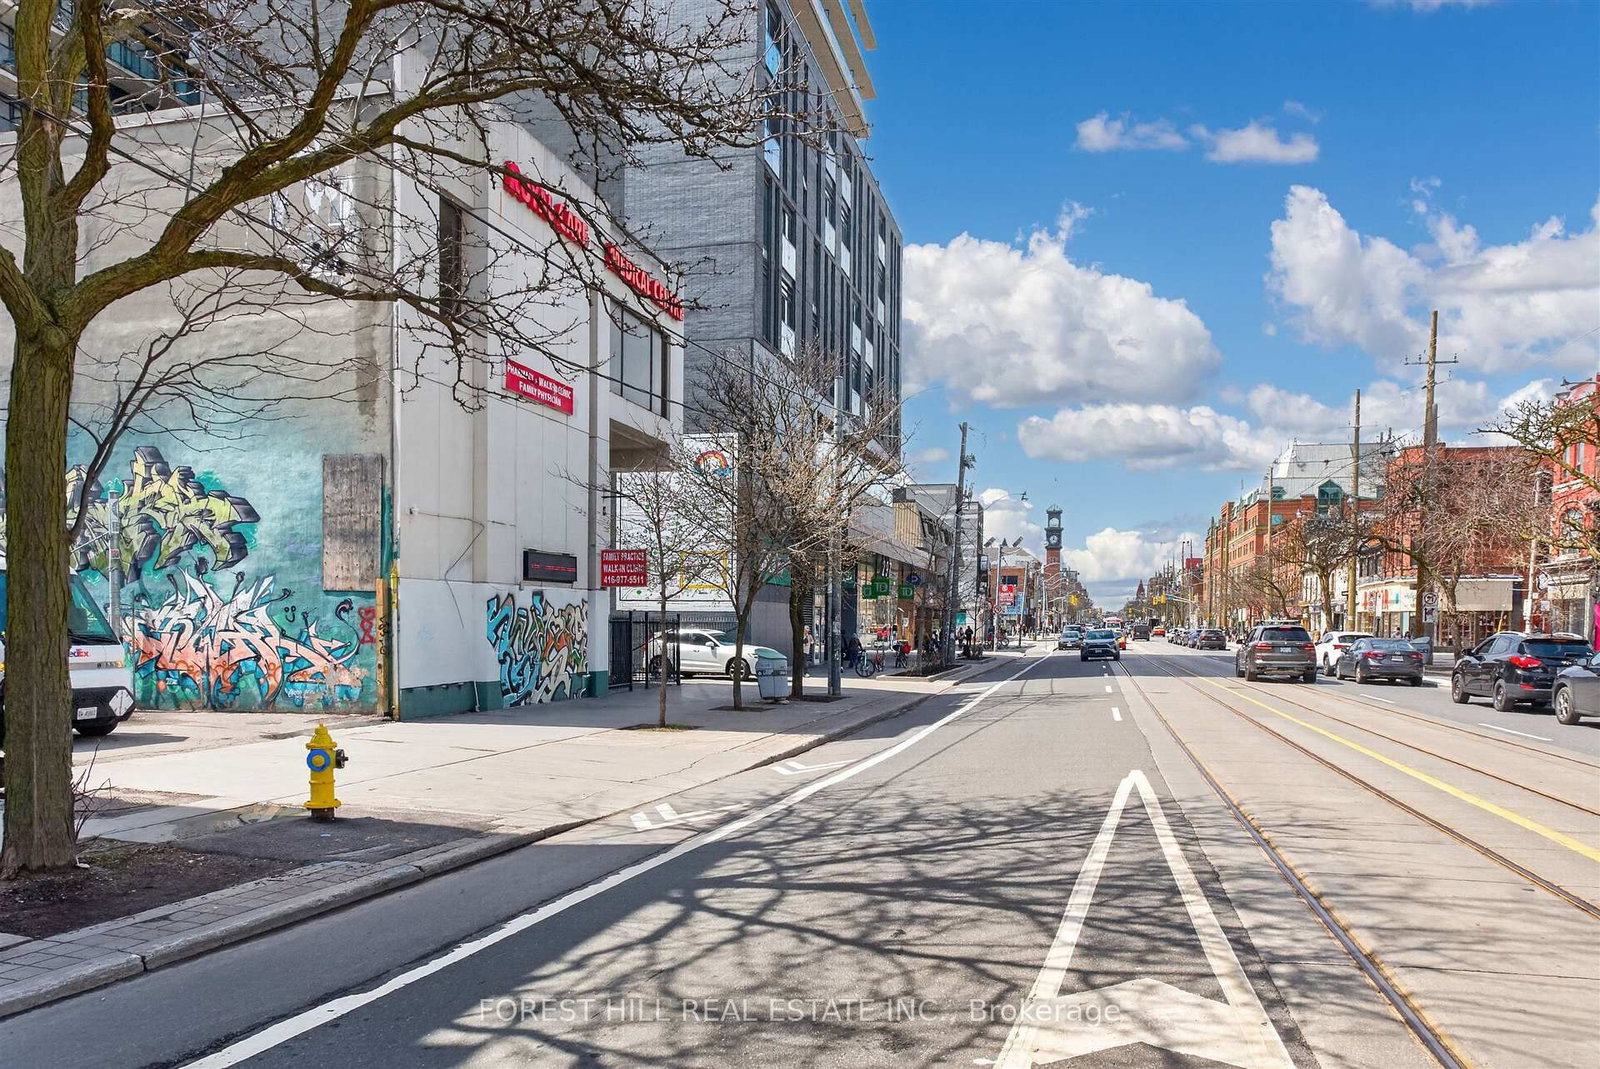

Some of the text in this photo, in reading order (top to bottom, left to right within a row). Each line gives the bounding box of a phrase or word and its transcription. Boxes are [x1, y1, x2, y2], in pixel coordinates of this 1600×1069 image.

[610, 246, 652, 295] MEDICAL
[519, 380, 538, 396] FAMILY
[603, 552, 645, 561] FAMILY PRACTICE
[603, 564, 645, 573] WALK-IN CLINIC
